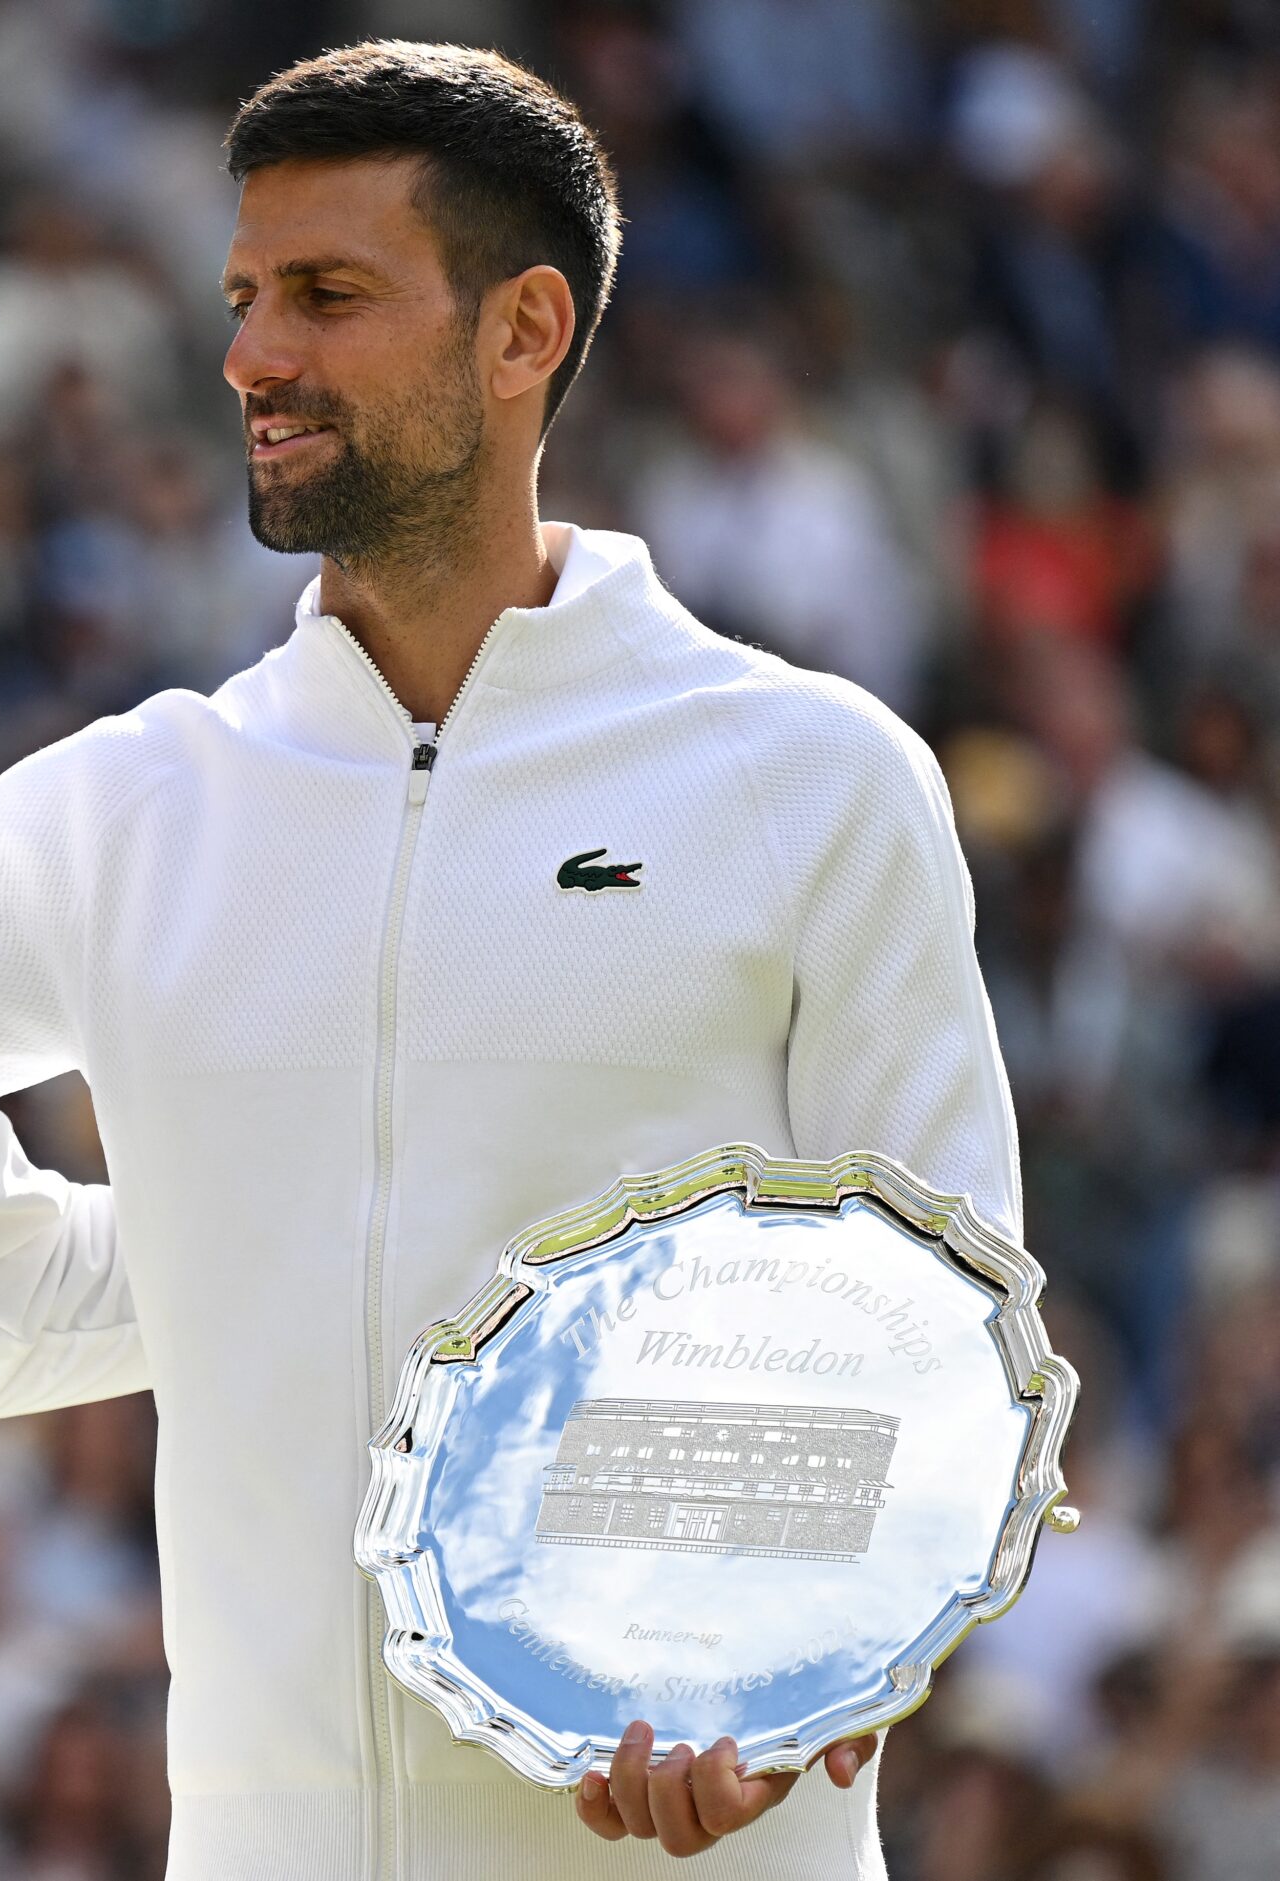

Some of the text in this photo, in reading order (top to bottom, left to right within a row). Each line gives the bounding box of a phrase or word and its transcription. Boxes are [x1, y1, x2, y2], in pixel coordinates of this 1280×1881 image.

[558, 1255, 943, 1377] The Championships
[634, 1330, 865, 1377] Wimbledon
[497, 1597, 648, 1701] Gentlemen's
[656, 1668, 774, 1705] Singles
[622, 1622, 724, 1648] Runner-up
